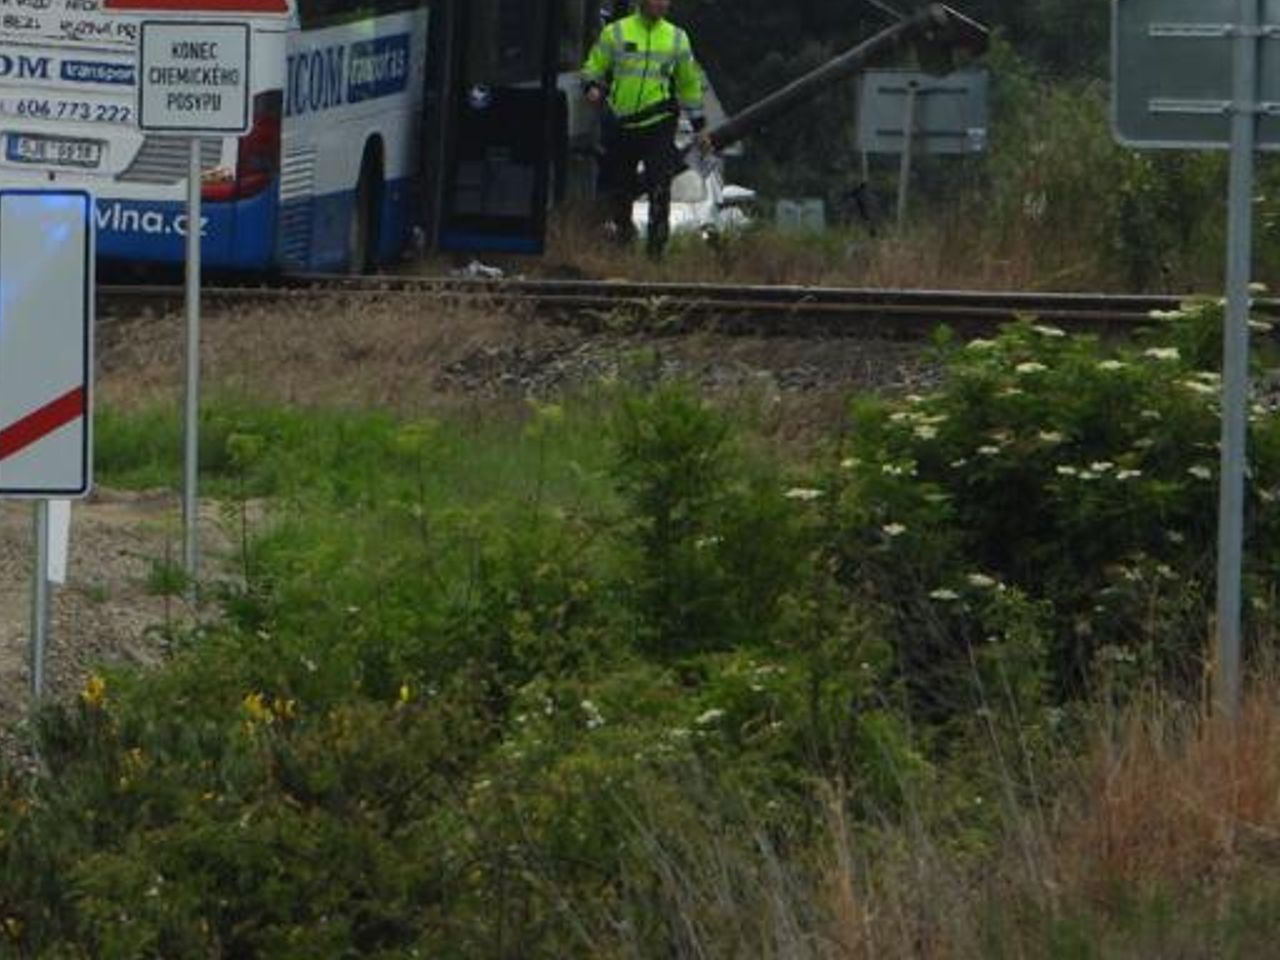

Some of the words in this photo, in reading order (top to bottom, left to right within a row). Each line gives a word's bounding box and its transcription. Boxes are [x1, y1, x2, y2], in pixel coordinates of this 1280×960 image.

[171, 41, 219, 60] KONEC
[66, 63, 133, 83] transpor
[149, 63, 239, 86] CHEMICKÉHO
[285, 44, 344, 117] ICOM
[16, 98, 51, 117] 606
[58, 101, 90, 120] 773
[94, 104, 132, 123] 222
[166, 92, 222, 112] POSYPU
